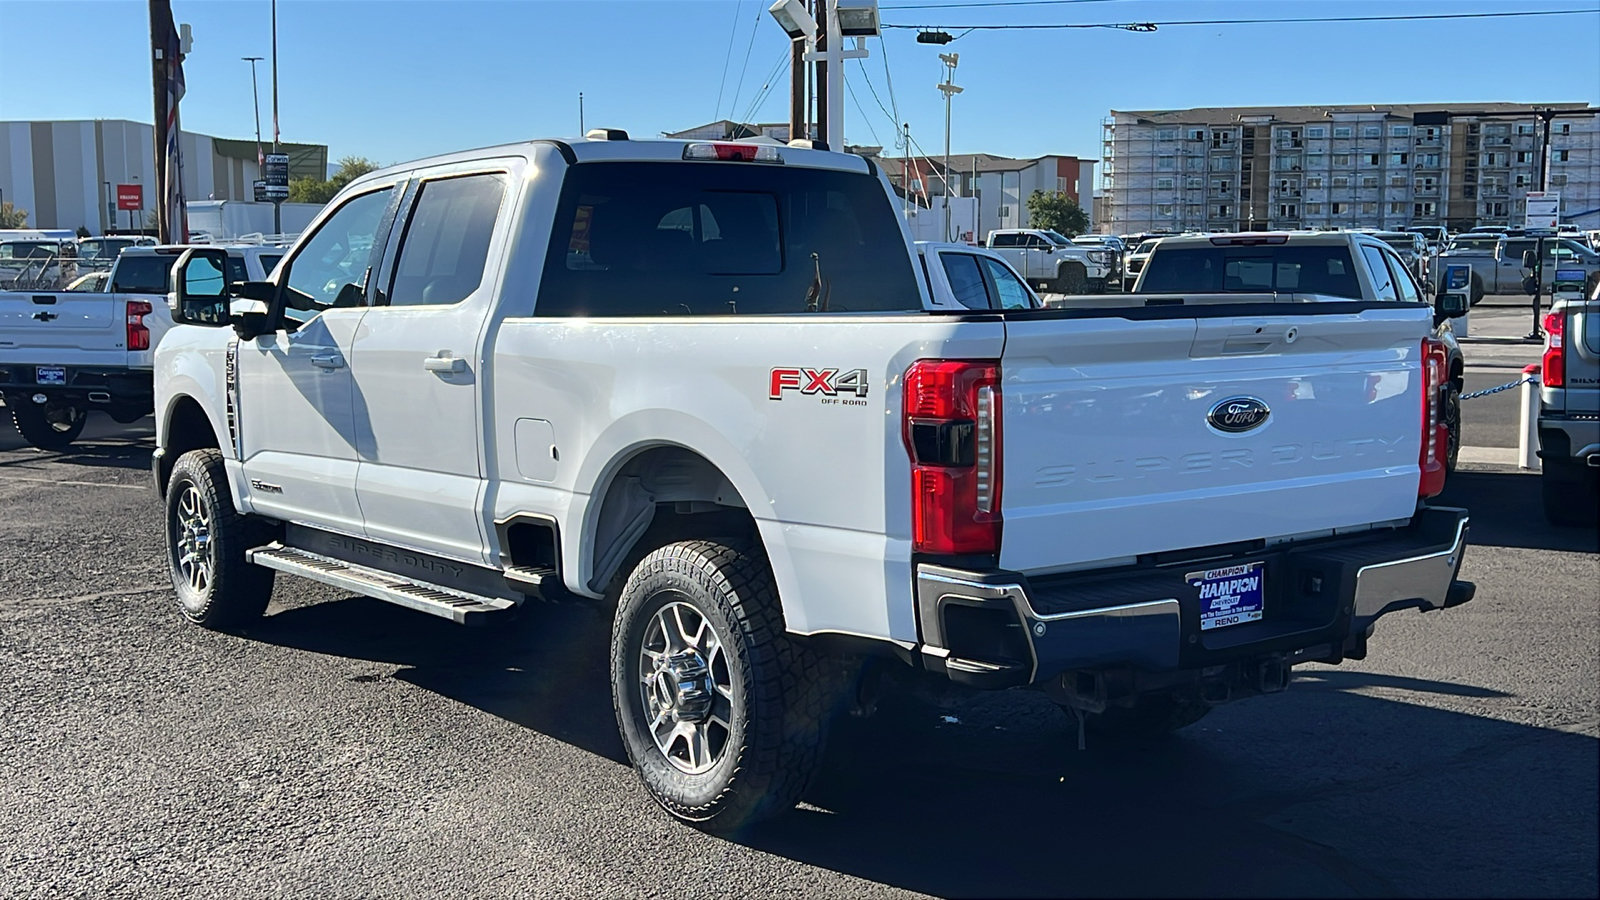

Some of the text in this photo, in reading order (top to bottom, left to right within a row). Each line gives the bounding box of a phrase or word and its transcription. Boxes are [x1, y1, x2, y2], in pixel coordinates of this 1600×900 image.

[769, 367, 869, 400] FX4
[1225, 404, 1257, 424] Ford
[1035, 436, 1404, 488] SUPER DUTY
[328, 537, 464, 578] SUPER DUTY
[1208, 565, 1245, 578] CHAMPION
[1215, 616, 1239, 626] RENO
